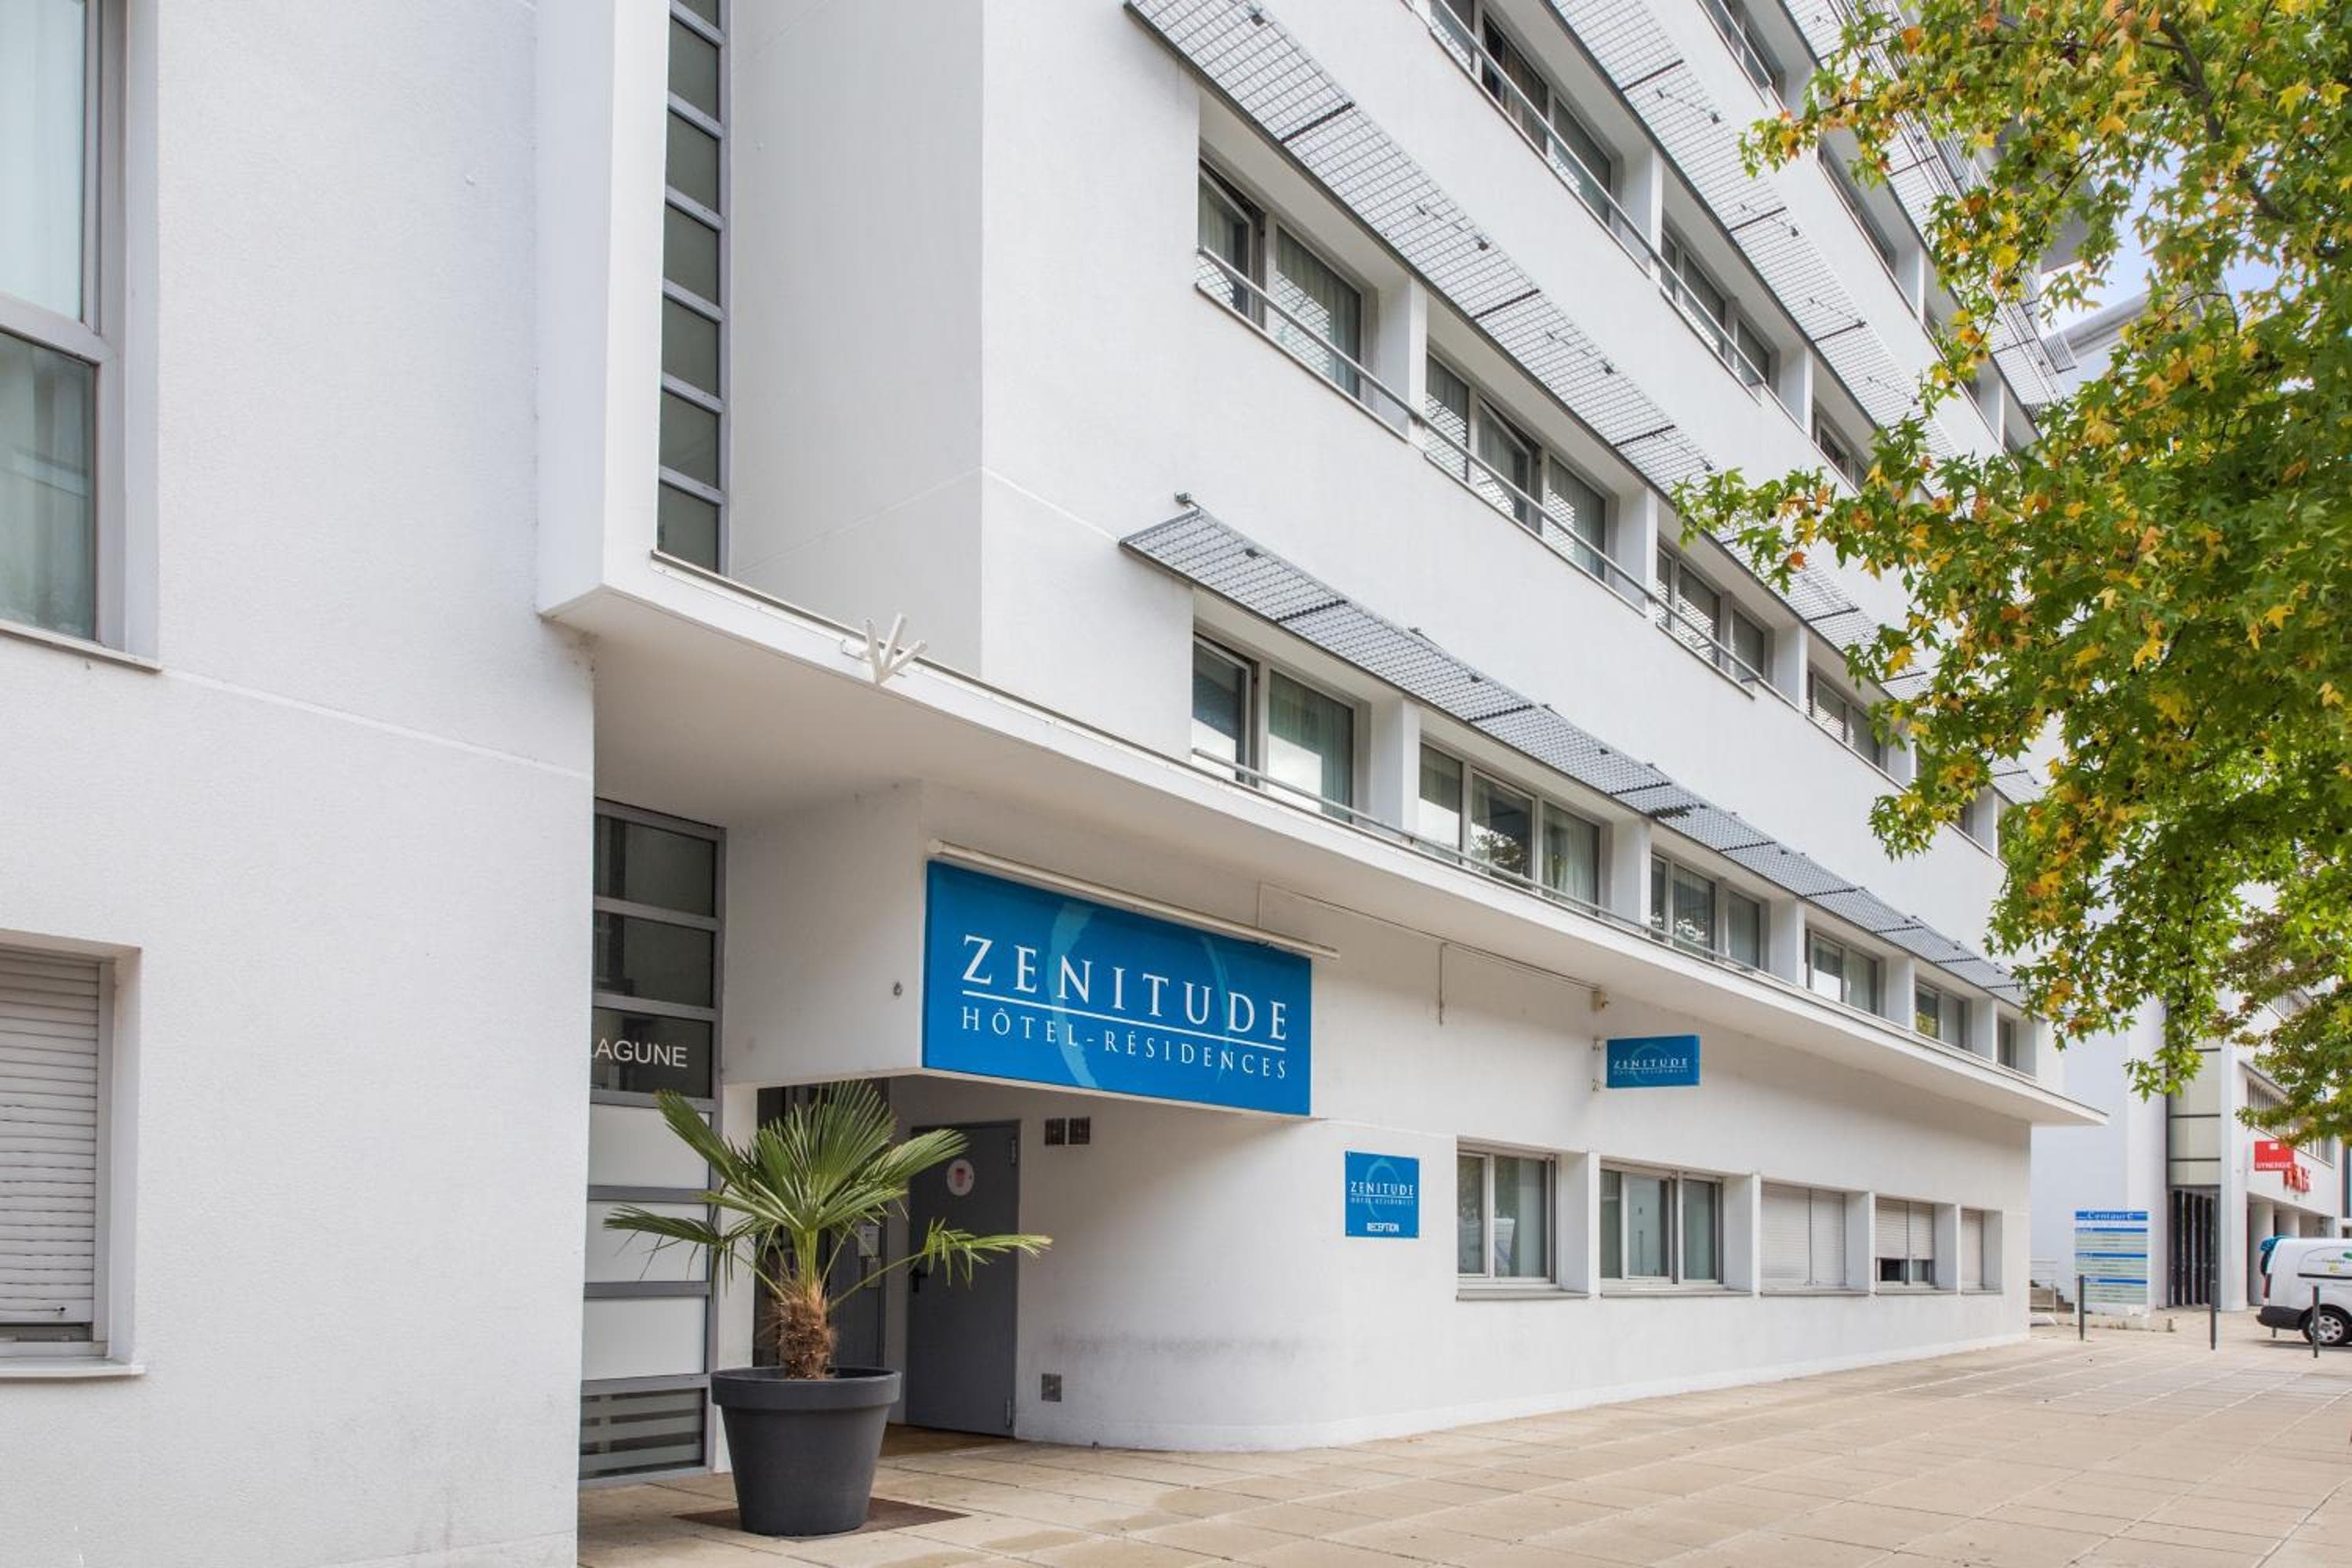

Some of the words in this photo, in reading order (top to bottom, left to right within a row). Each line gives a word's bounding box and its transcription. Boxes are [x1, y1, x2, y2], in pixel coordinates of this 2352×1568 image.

[962, 933, 1287, 1041] ZENITUDE
[591, 1037, 688, 1068] AGUNE
[1350, 1180, 1415, 1196] ZENITUDE
